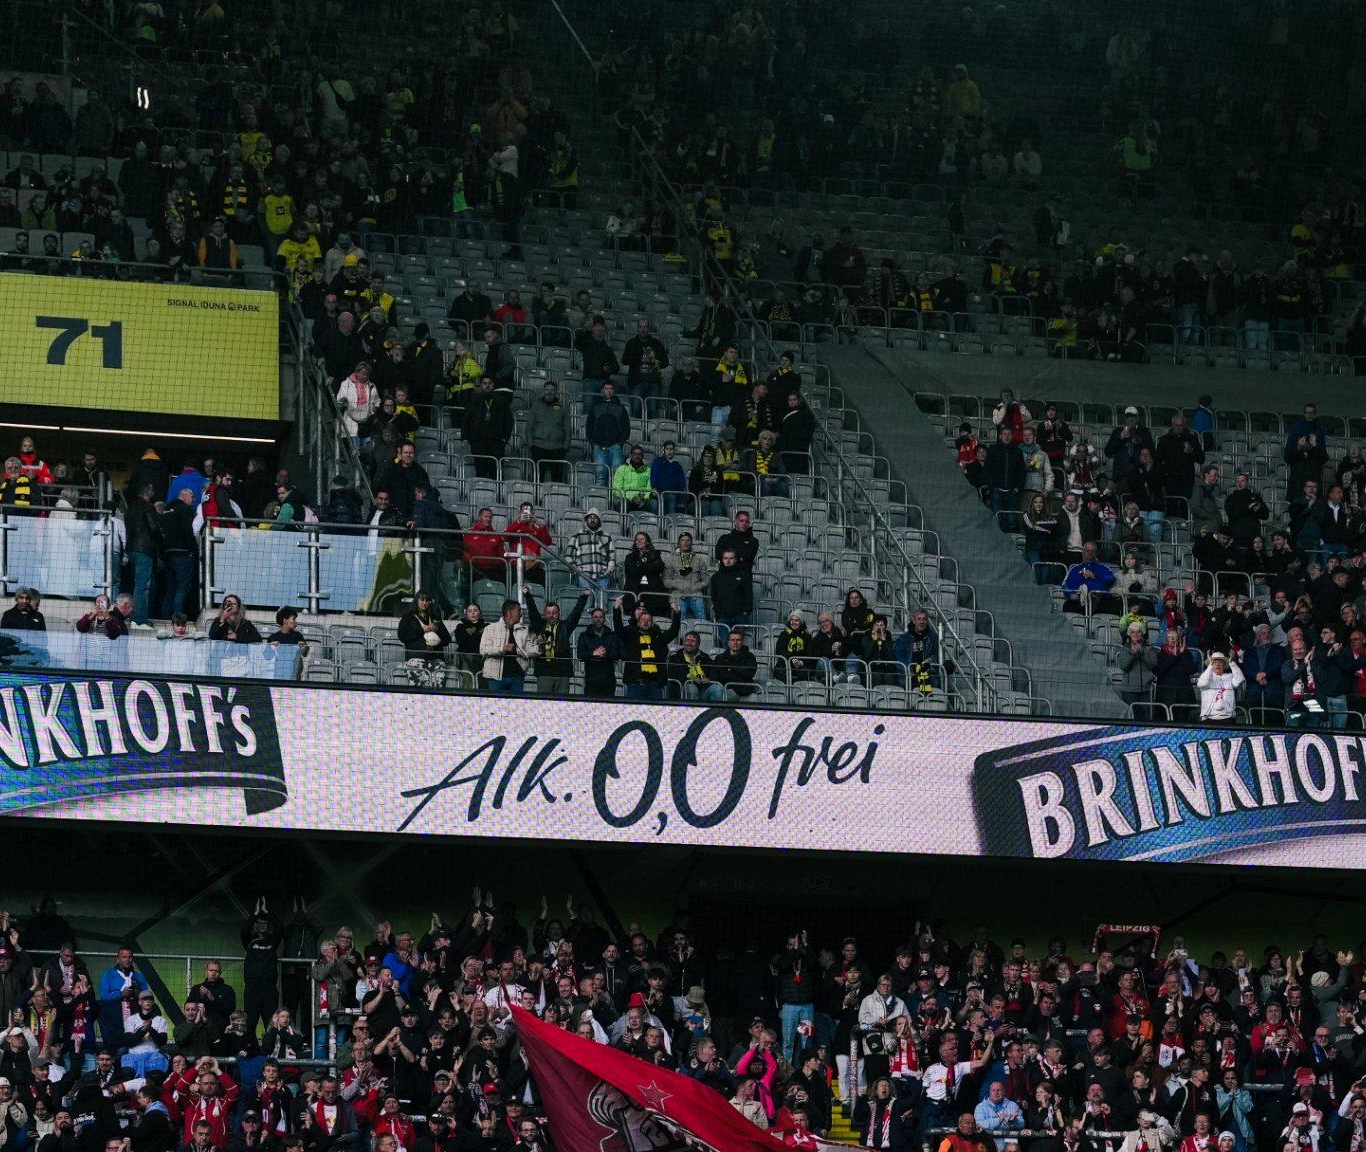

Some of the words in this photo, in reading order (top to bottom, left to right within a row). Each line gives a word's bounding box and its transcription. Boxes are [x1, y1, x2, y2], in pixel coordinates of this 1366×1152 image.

[166, 298, 198, 309] SIGNAL
[200, 300, 227, 310] IDUNA
[237, 302, 261, 312] PARK
[35, 316, 123, 369] 71
[400, 734, 573, 832] Alk.
[592, 707, 752, 836] 0,0
[769, 717, 884, 820] frei
